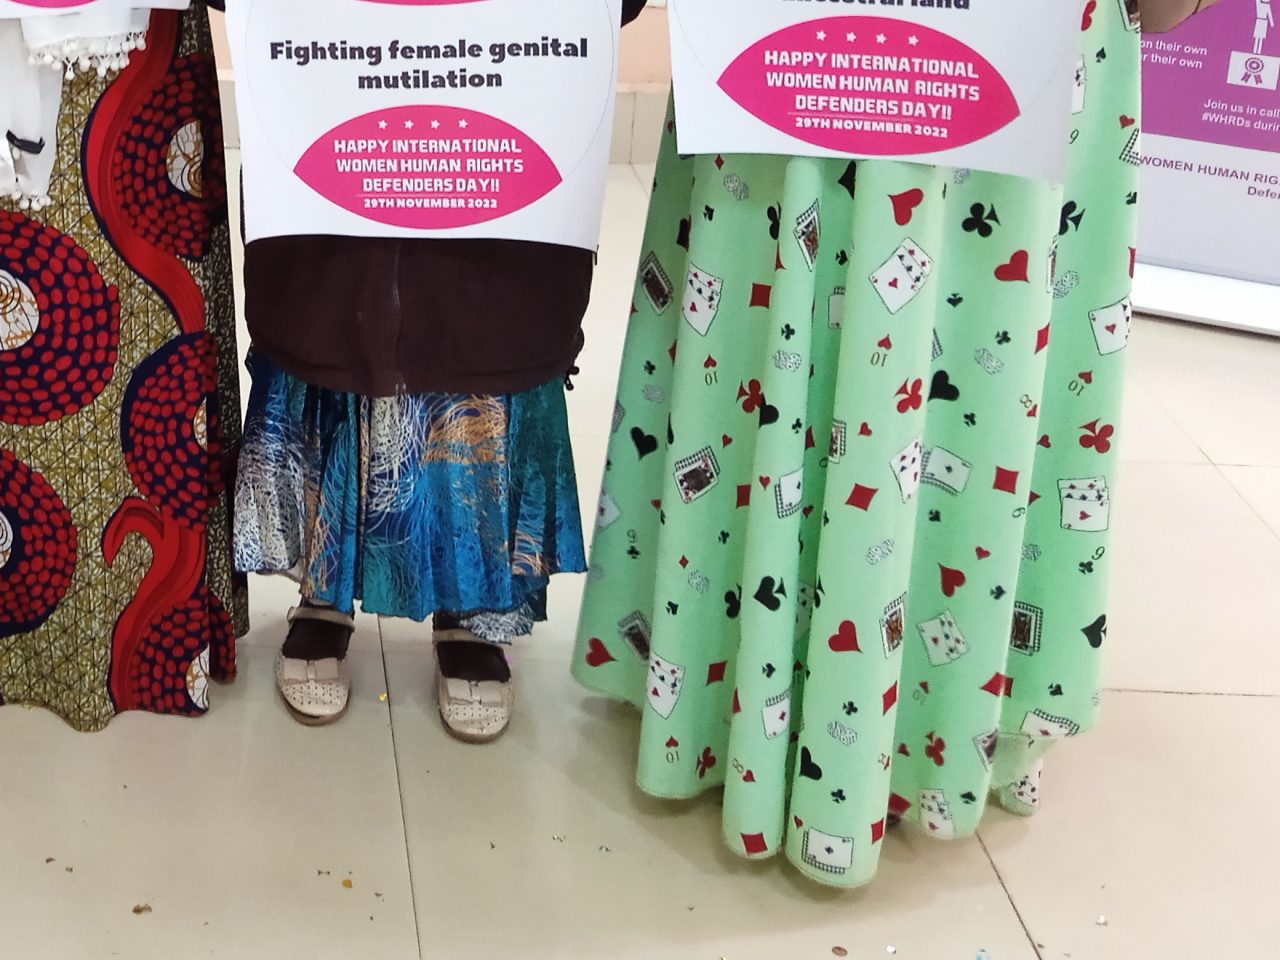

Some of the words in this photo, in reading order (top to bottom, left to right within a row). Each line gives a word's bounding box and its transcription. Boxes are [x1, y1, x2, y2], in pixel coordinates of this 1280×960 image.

[270, 40, 382, 65] Fighting
[387, 40, 482, 60] female
[489, 37, 588, 64] genital
[764, 50, 827, 68] HAPPY
[831, 53, 979, 79] INTERNATIONAL
[358, 68, 502, 90] mutilation
[766, 72, 836, 91] WOMEN
[839, 76, 908, 95] HUMAN
[915, 81, 980, 101] RIGHTS
[795, 95, 898, 116] DEFENDERS
[795, 116, 830, 129] 29TH
[832, 119, 912, 135] NOVEMBER
[915, 124, 948, 138] 2022
[334, 140, 389, 154] HAPPY
[393, 139, 521, 153] INTERNATIONAL
[336, 158, 398, 172] WOMEN
[401, 158, 461, 172] HUMAN
[467, 158, 523, 172] RIGHTS
[362, 178, 453, 192] DEFENDERS
[364, 198, 395, 208] 29TH
[397, 198, 466, 208] NOVEMBER
[468, 198, 497, 208] 2022
